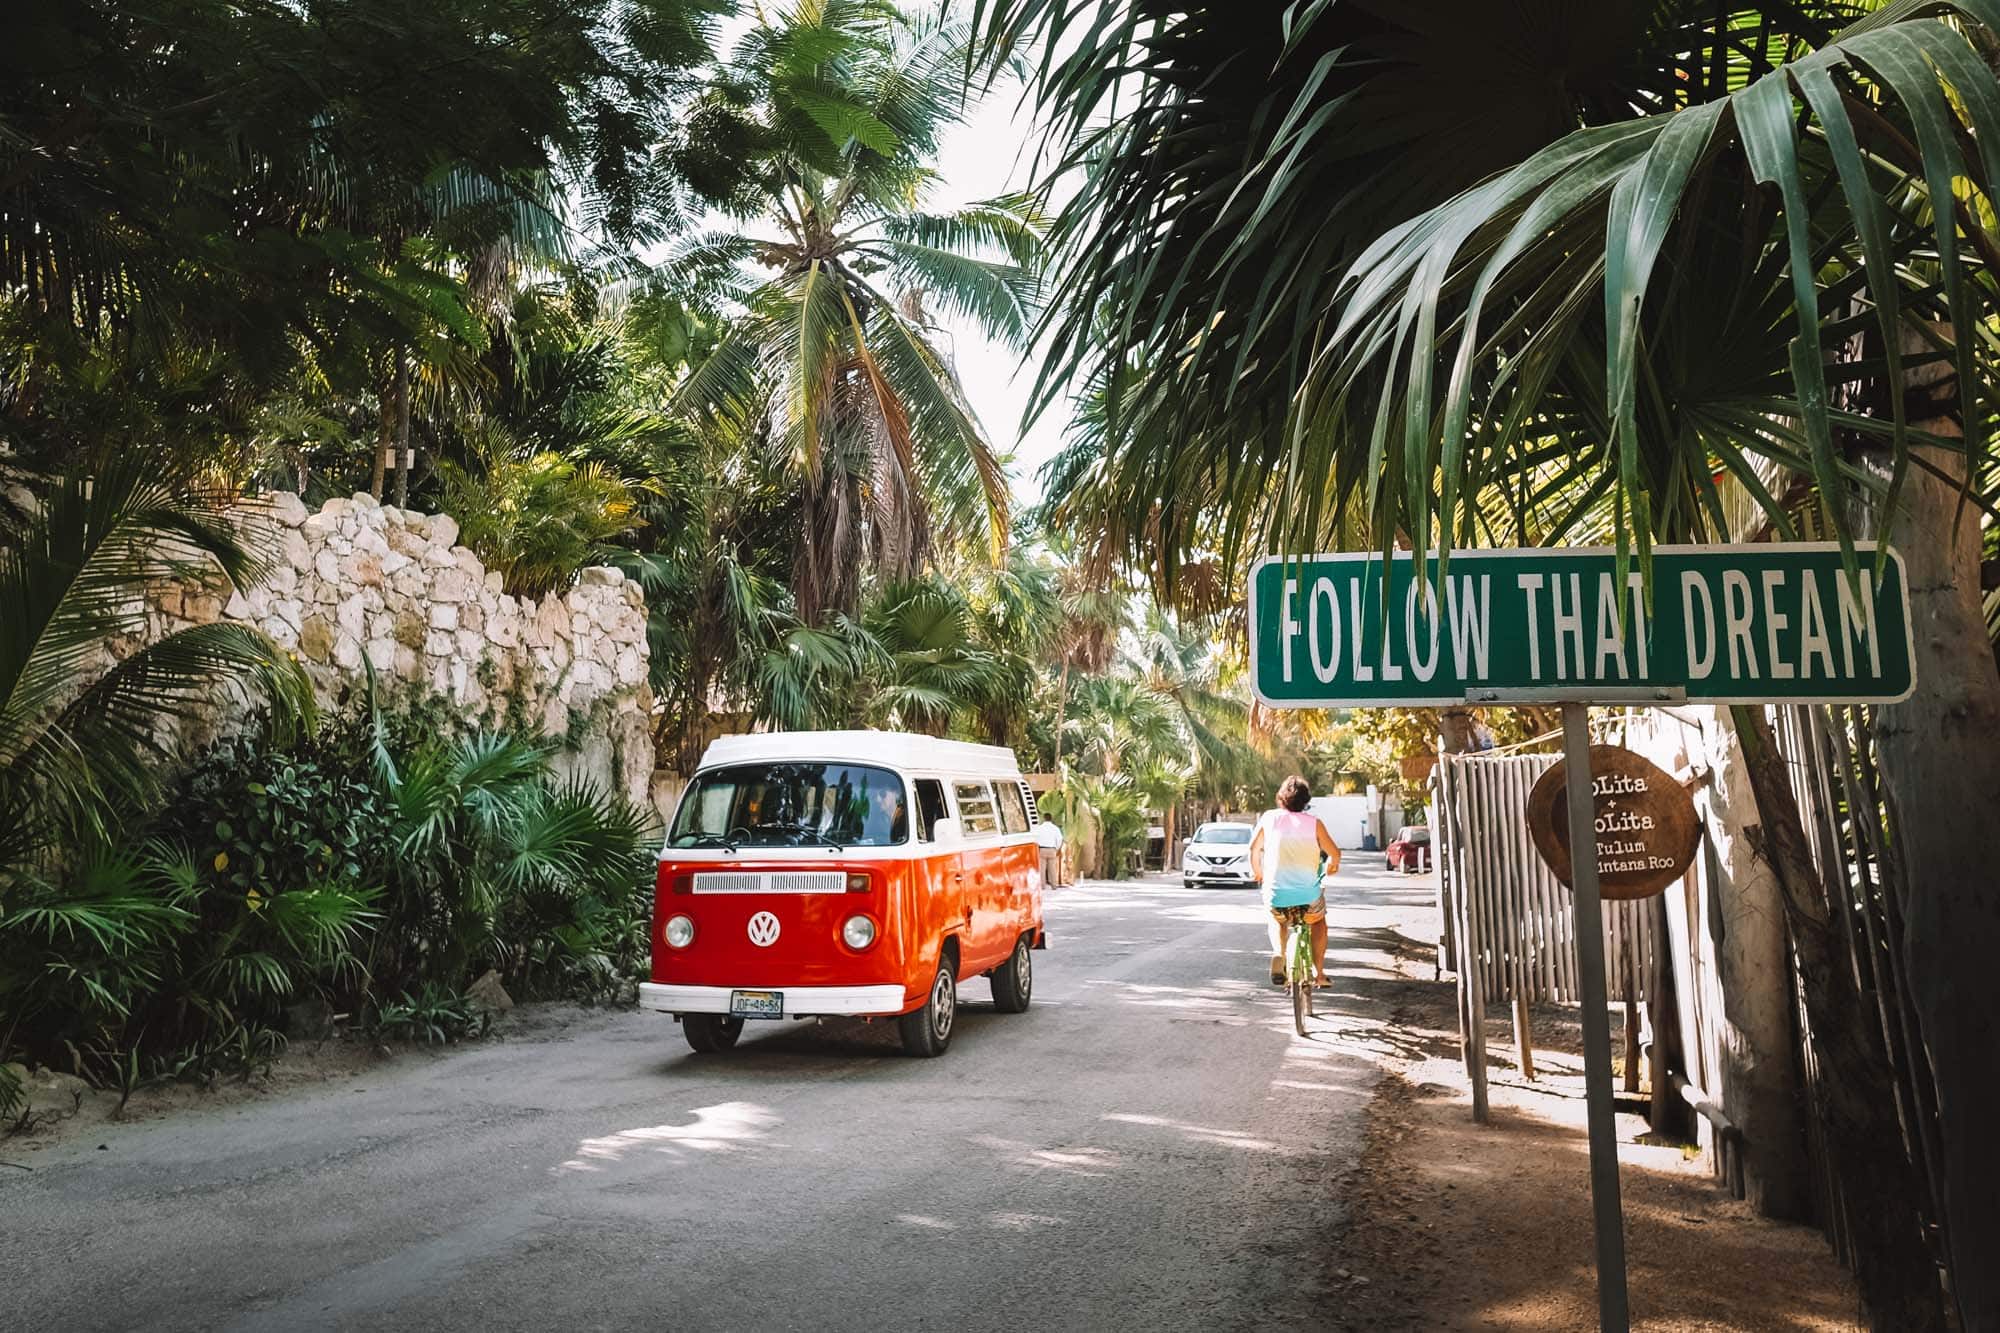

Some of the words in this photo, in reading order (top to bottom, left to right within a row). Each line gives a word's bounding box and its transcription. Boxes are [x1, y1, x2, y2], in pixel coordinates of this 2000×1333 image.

[1282, 576, 1490, 683] FOLLOW
[1518, 571, 1648, 681] THAT
[1681, 569, 1881, 680] DREAM
[1594, 812, 1655, 833] oLita
[1598, 859, 1646, 873] intana
[1649, 856, 1675, 869] Roo
